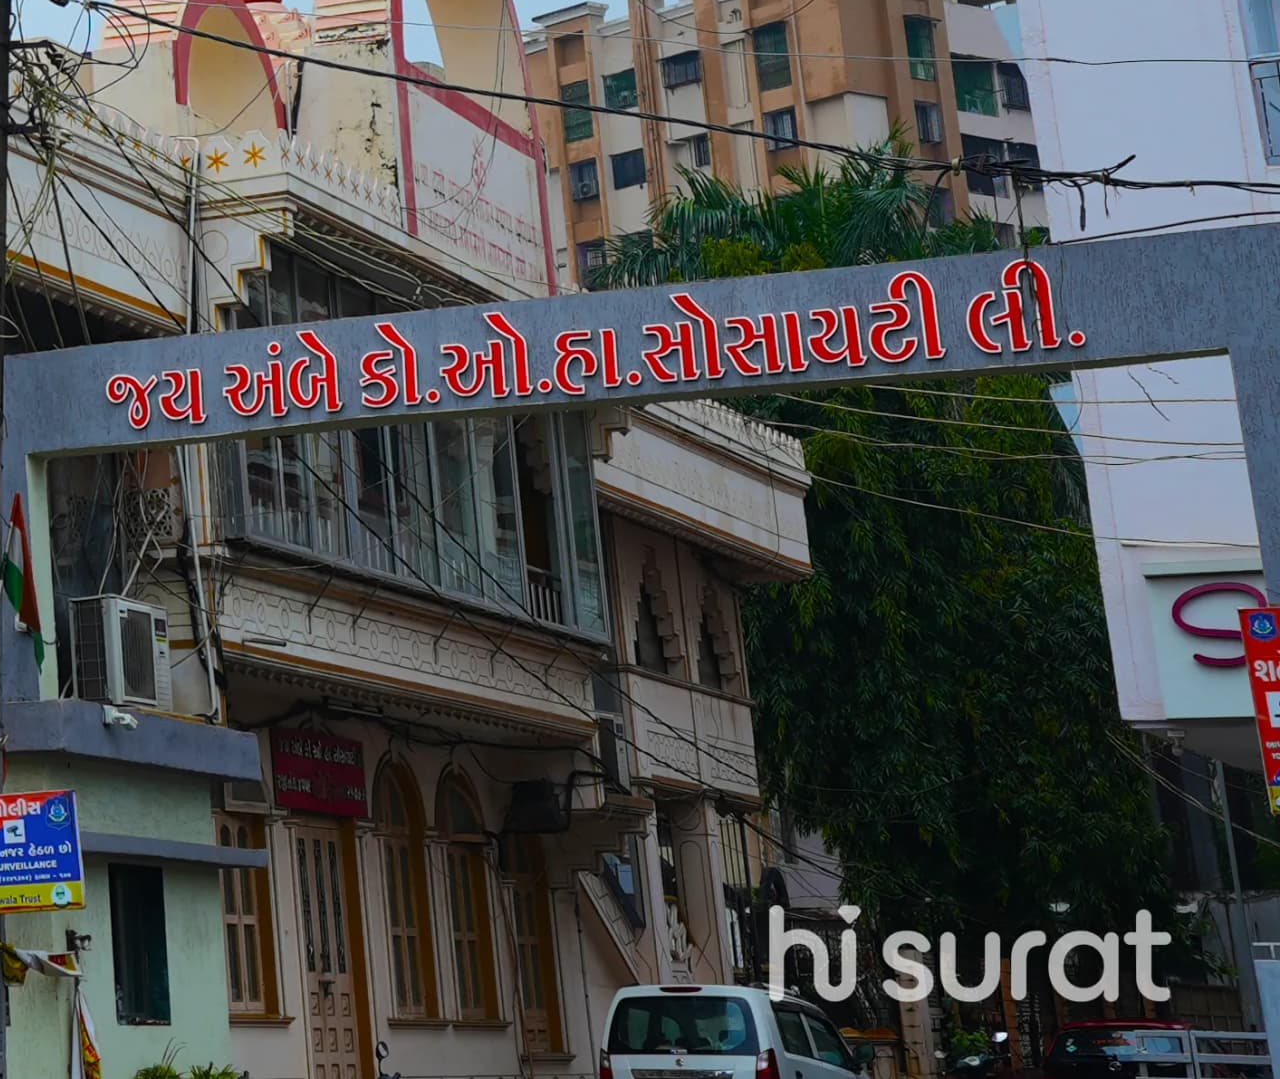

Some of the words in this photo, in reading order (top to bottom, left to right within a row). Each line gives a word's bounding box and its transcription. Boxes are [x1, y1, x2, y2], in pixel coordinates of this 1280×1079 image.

[105, 368, 207, 429] જય
[224, 329, 342, 417] અંબે
[0, 847, 24, 858] નજર
[28, 842, 54, 857] હેઠળ
[58, 840, 72, 854] છો
[19, 892, 42, 904] Trust
